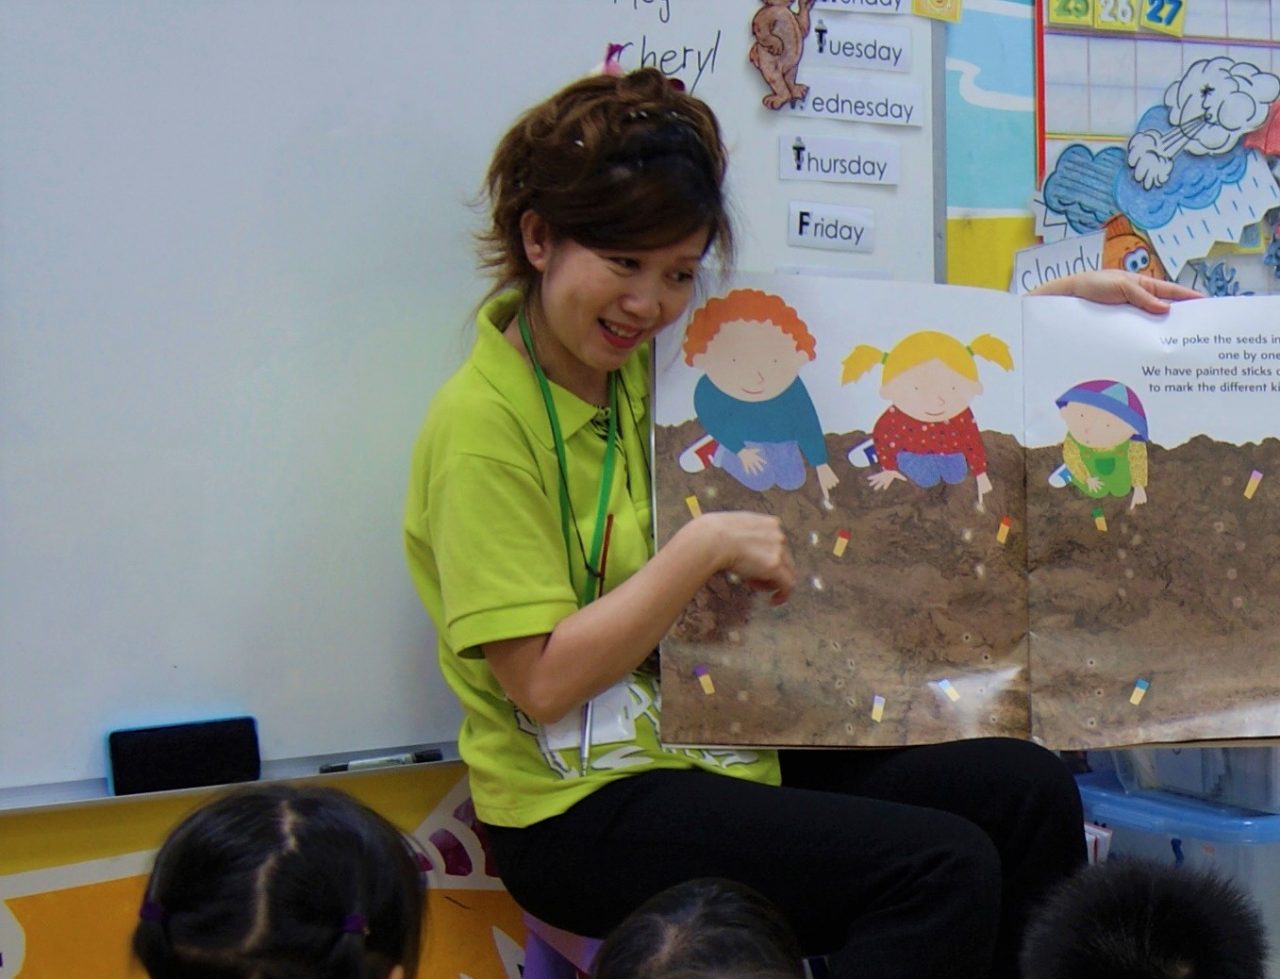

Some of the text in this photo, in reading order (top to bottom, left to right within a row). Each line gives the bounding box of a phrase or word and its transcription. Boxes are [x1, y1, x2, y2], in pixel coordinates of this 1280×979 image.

[1146, 0, 1183, 26] 27
[815, 22, 903, 65] Tuesday
[793, 141, 888, 181] Thursday
[798, 211, 865, 245] Friday
[1183, 335, 1209, 346] poke
[1214, 334, 1231, 345] the
[1236, 335, 1267, 345] seeds
[1218, 352, 1239, 360] one
[1243, 351, 1257, 363] by
[1141, 366, 1161, 376] We
[1165, 366, 1192, 376] have
[1196, 366, 1238, 379] painted
[1241, 366, 1272, 376] sticks
[1149, 383, 1161, 392] to
[1165, 382, 1193, 392] mark
[1198, 382, 1216, 392] the
[1220, 382, 1267, 392] different
